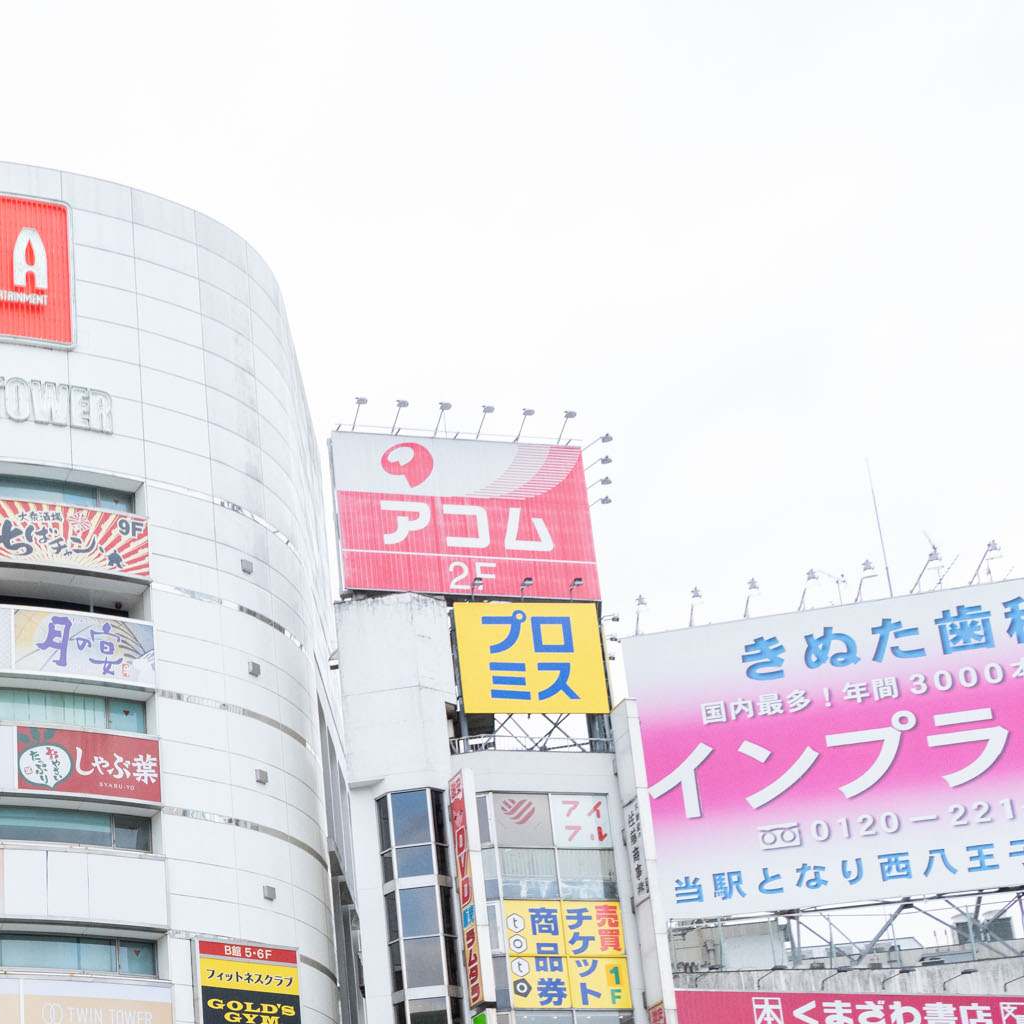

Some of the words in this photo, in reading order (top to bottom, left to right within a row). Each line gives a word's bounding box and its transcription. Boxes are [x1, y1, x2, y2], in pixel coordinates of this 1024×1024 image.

[17, 511, 63, 522] 大衆酒場
[117, 517, 144, 538] 9F
[380, 499, 555, 552] アコム
[448, 561, 497, 591] 2F
[36, 616, 123, 676] 月の宴
[75, 746, 159, 785] しゃぶ葉
[648, 708, 1011, 820] インプラ
[595, 904, 622, 952] 売買
[224, 945, 241, 957] B館
[528, 907, 568, 1006] 商品券
[565, 907, 602, 1005] チケット
[206, 968, 293, 988] フィットネスクラブ
[68, 1007, 103, 1024] TWIN
[207, 998, 296, 1017] GOLD'S
